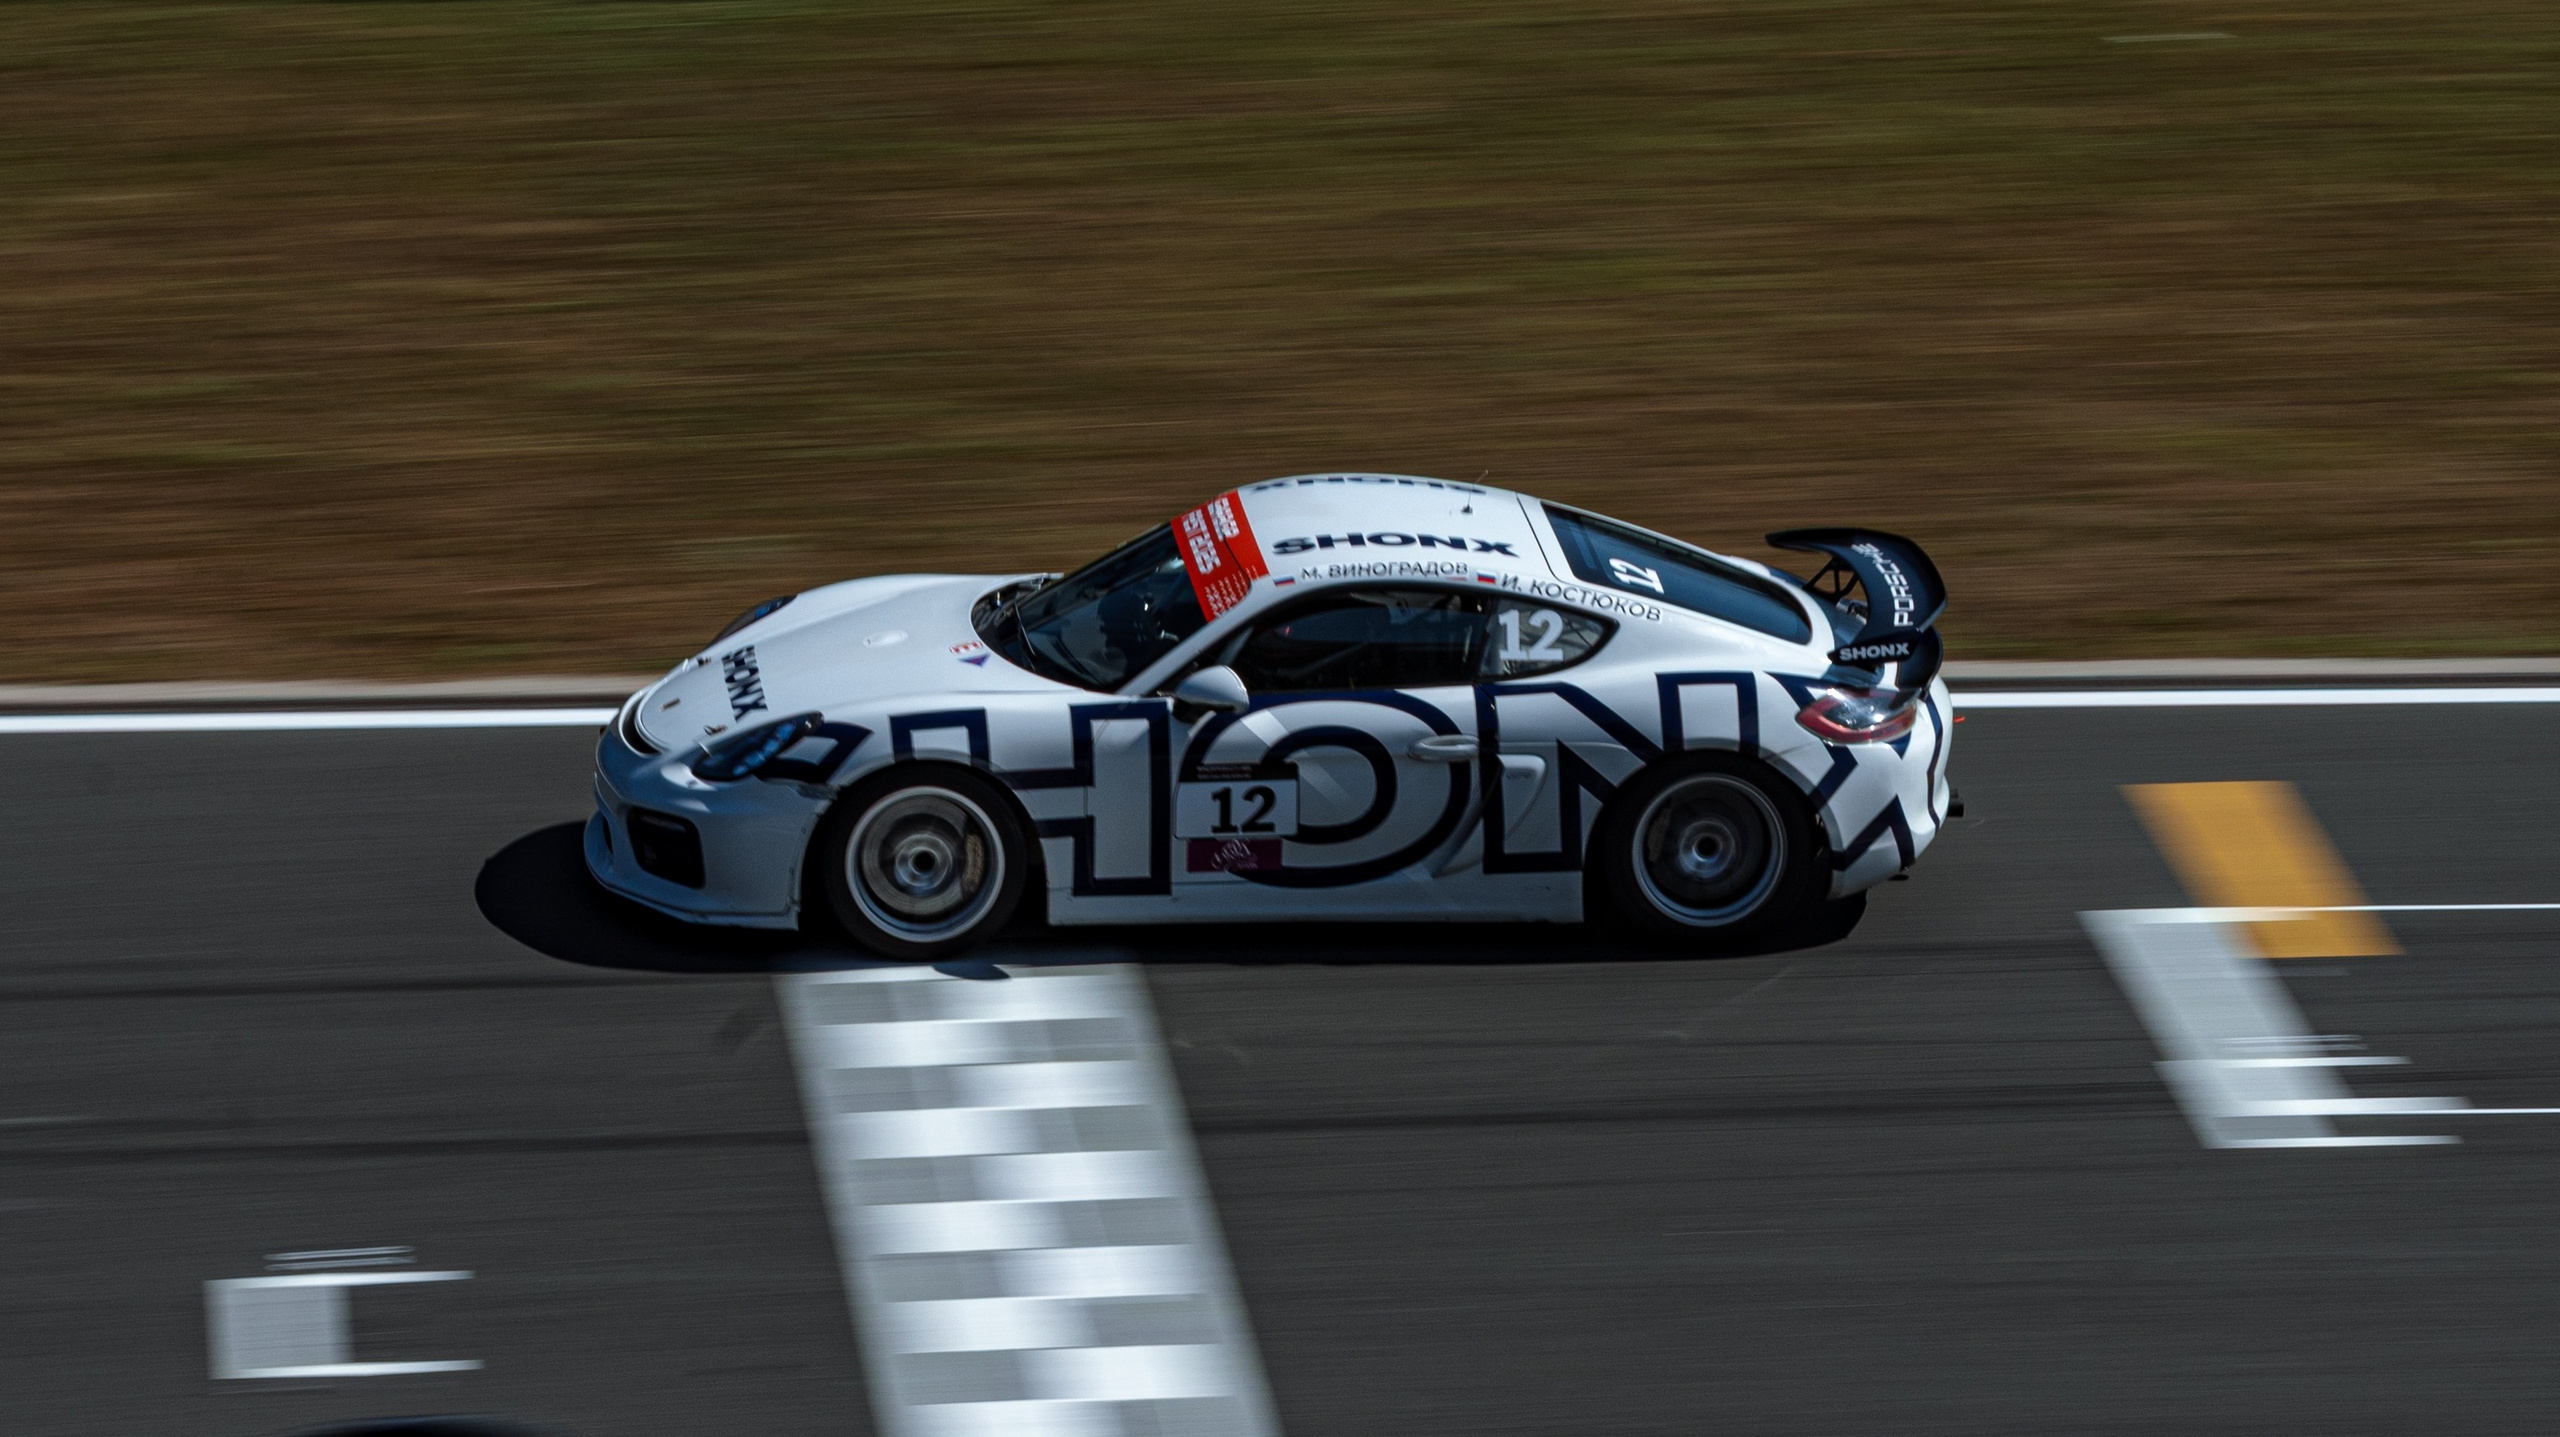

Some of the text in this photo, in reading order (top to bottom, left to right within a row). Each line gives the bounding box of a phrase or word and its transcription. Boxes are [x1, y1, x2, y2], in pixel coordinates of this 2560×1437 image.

[1272, 531, 1520, 558] SHONX
[1301, 561, 1468, 581] М. ВИНОГРАДОВ
[1608, 558, 1665, 594] 12
[1851, 543, 1914, 627] PORSCHE
[1530, 578, 1662, 622] КОСТЮКОВ
[1498, 609, 1564, 661] 12
[1840, 643, 1909, 660] SHONX
[721, 644, 769, 723] SHONX
[1211, 785, 1275, 833] 12
